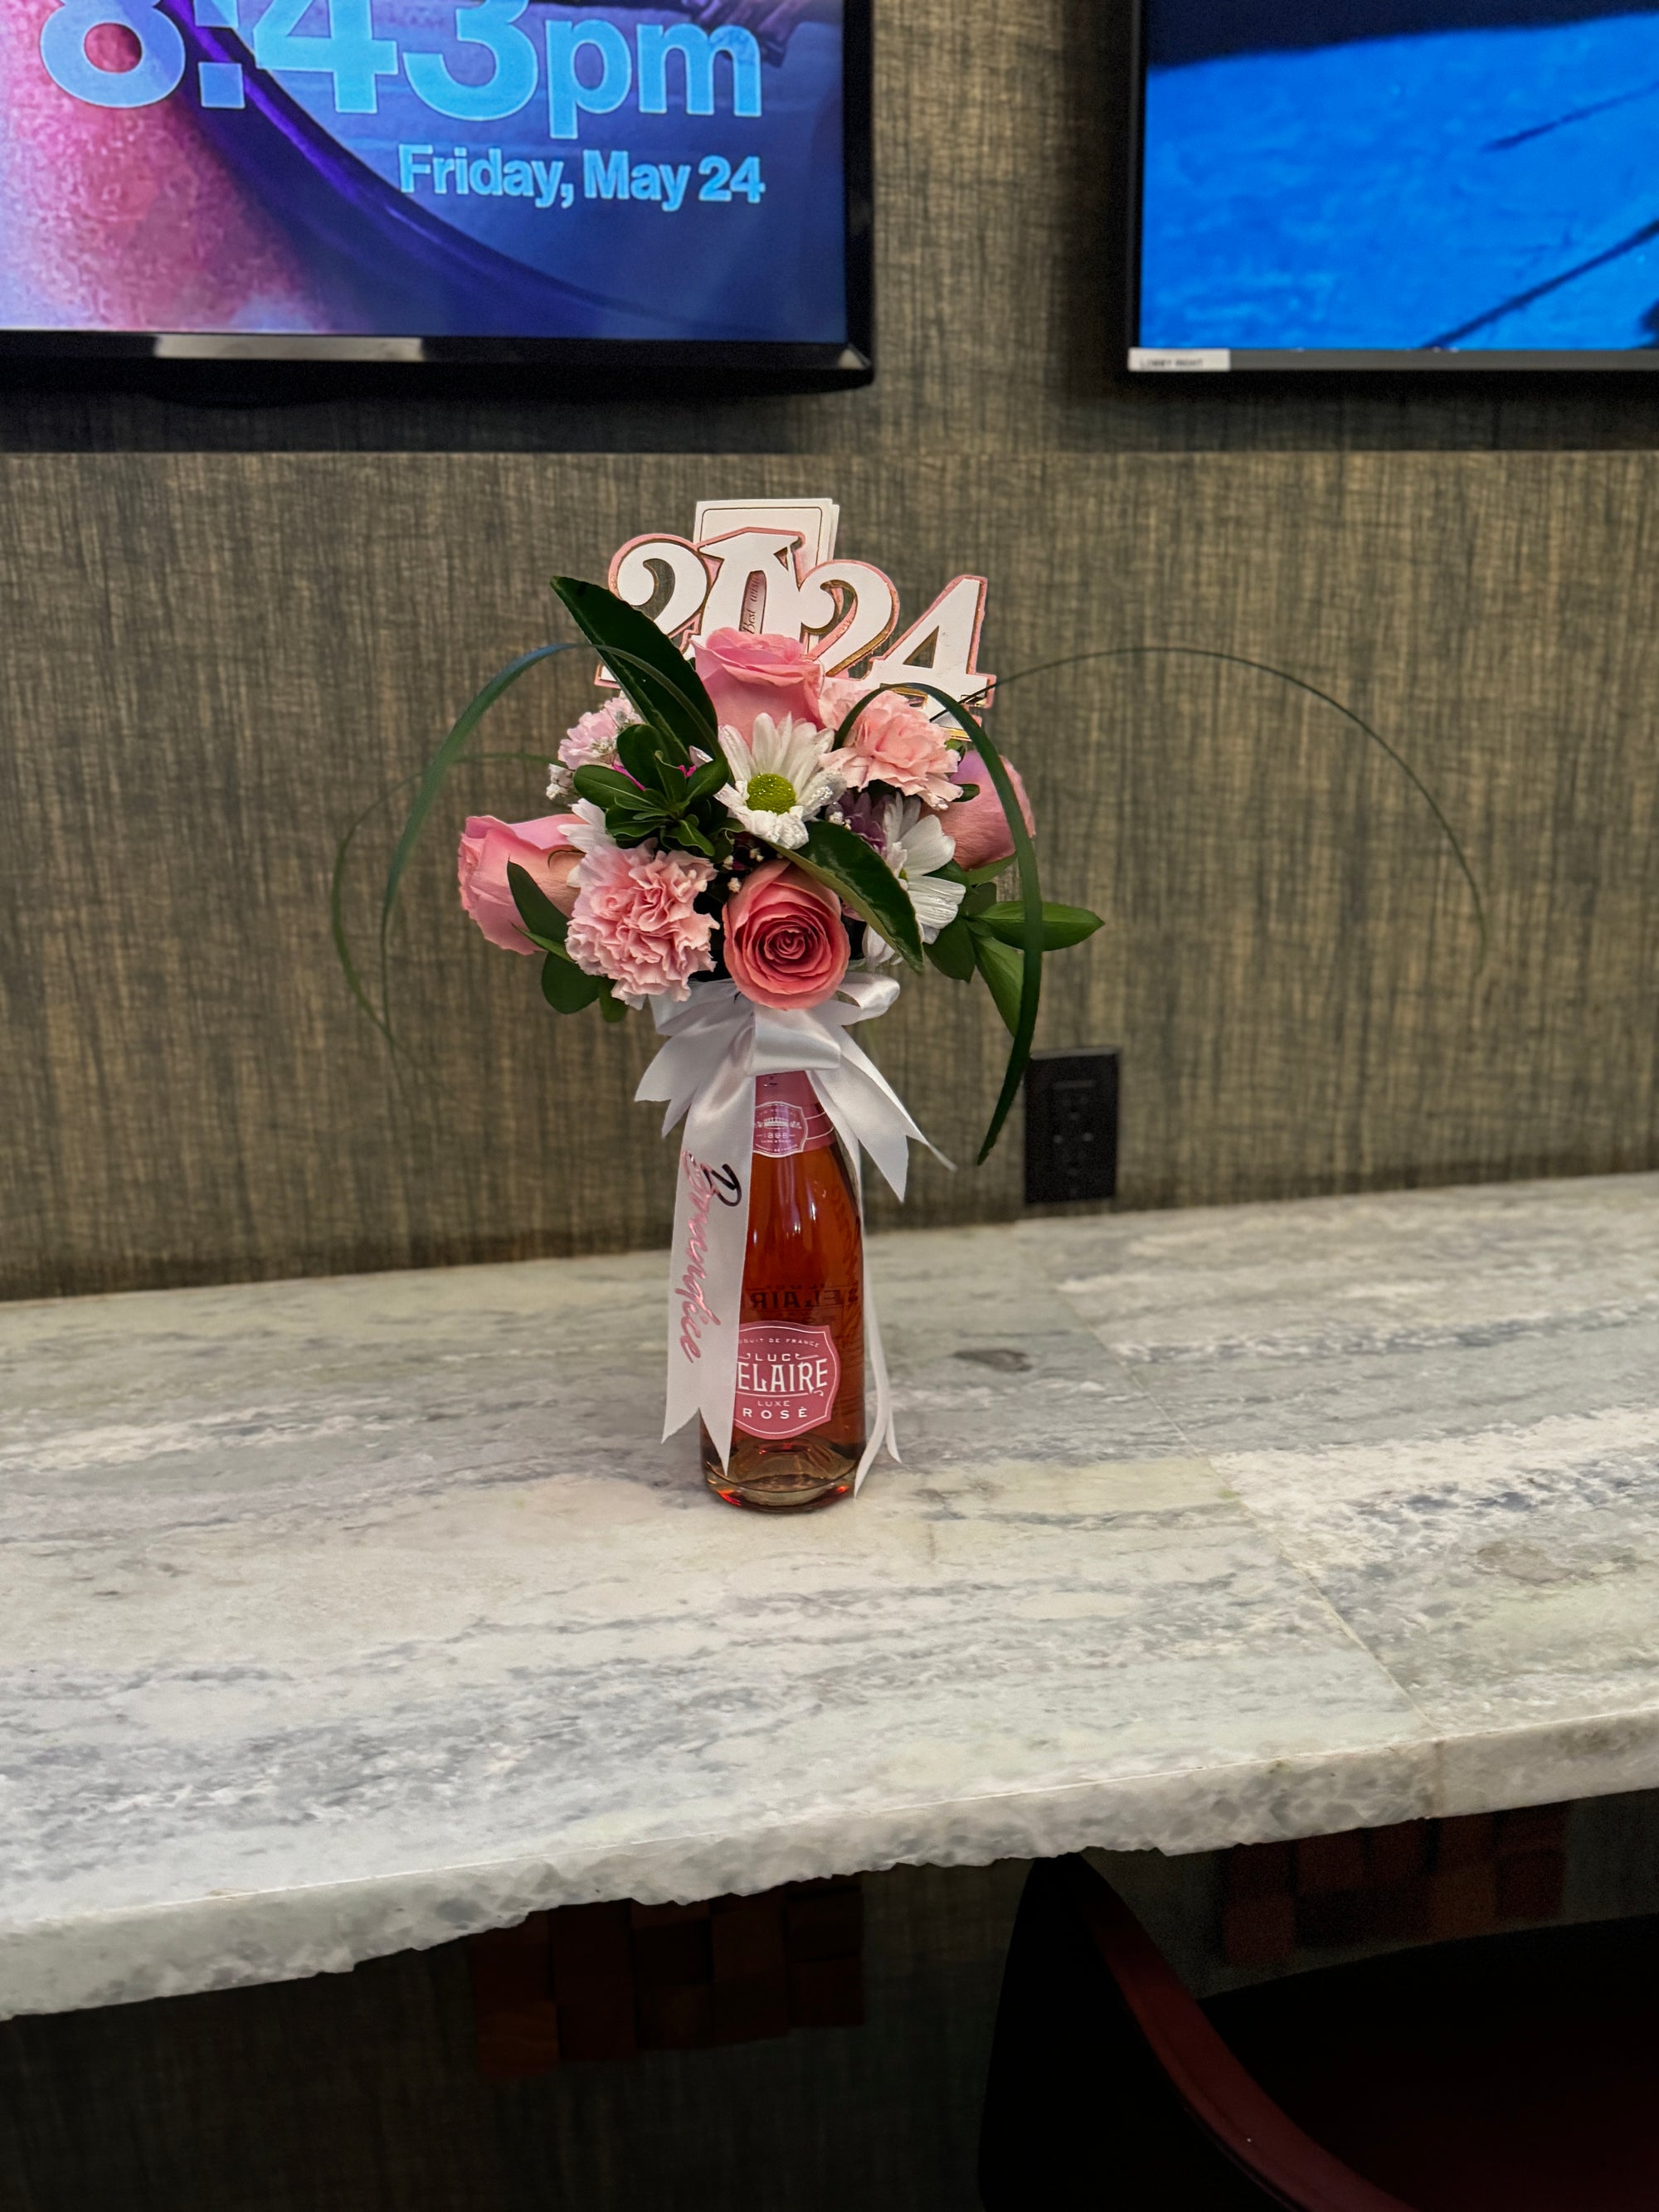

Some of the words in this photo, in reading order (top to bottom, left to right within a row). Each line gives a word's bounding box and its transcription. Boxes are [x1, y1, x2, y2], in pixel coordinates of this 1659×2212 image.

[397, 143, 573, 208] Friday,
[583, 150, 690, 211] May
[698, 156, 766, 204] 24
[742, 609, 756, 634] Best
[675, 1150, 742, 1364] Brandice
[786, 1338, 820, 1348] FRANCE
[755, 1353, 791, 1362] LUC
[737, 1358, 829, 1394] ELAIRE
[742, 1407, 808, 1420] ROSÉ
